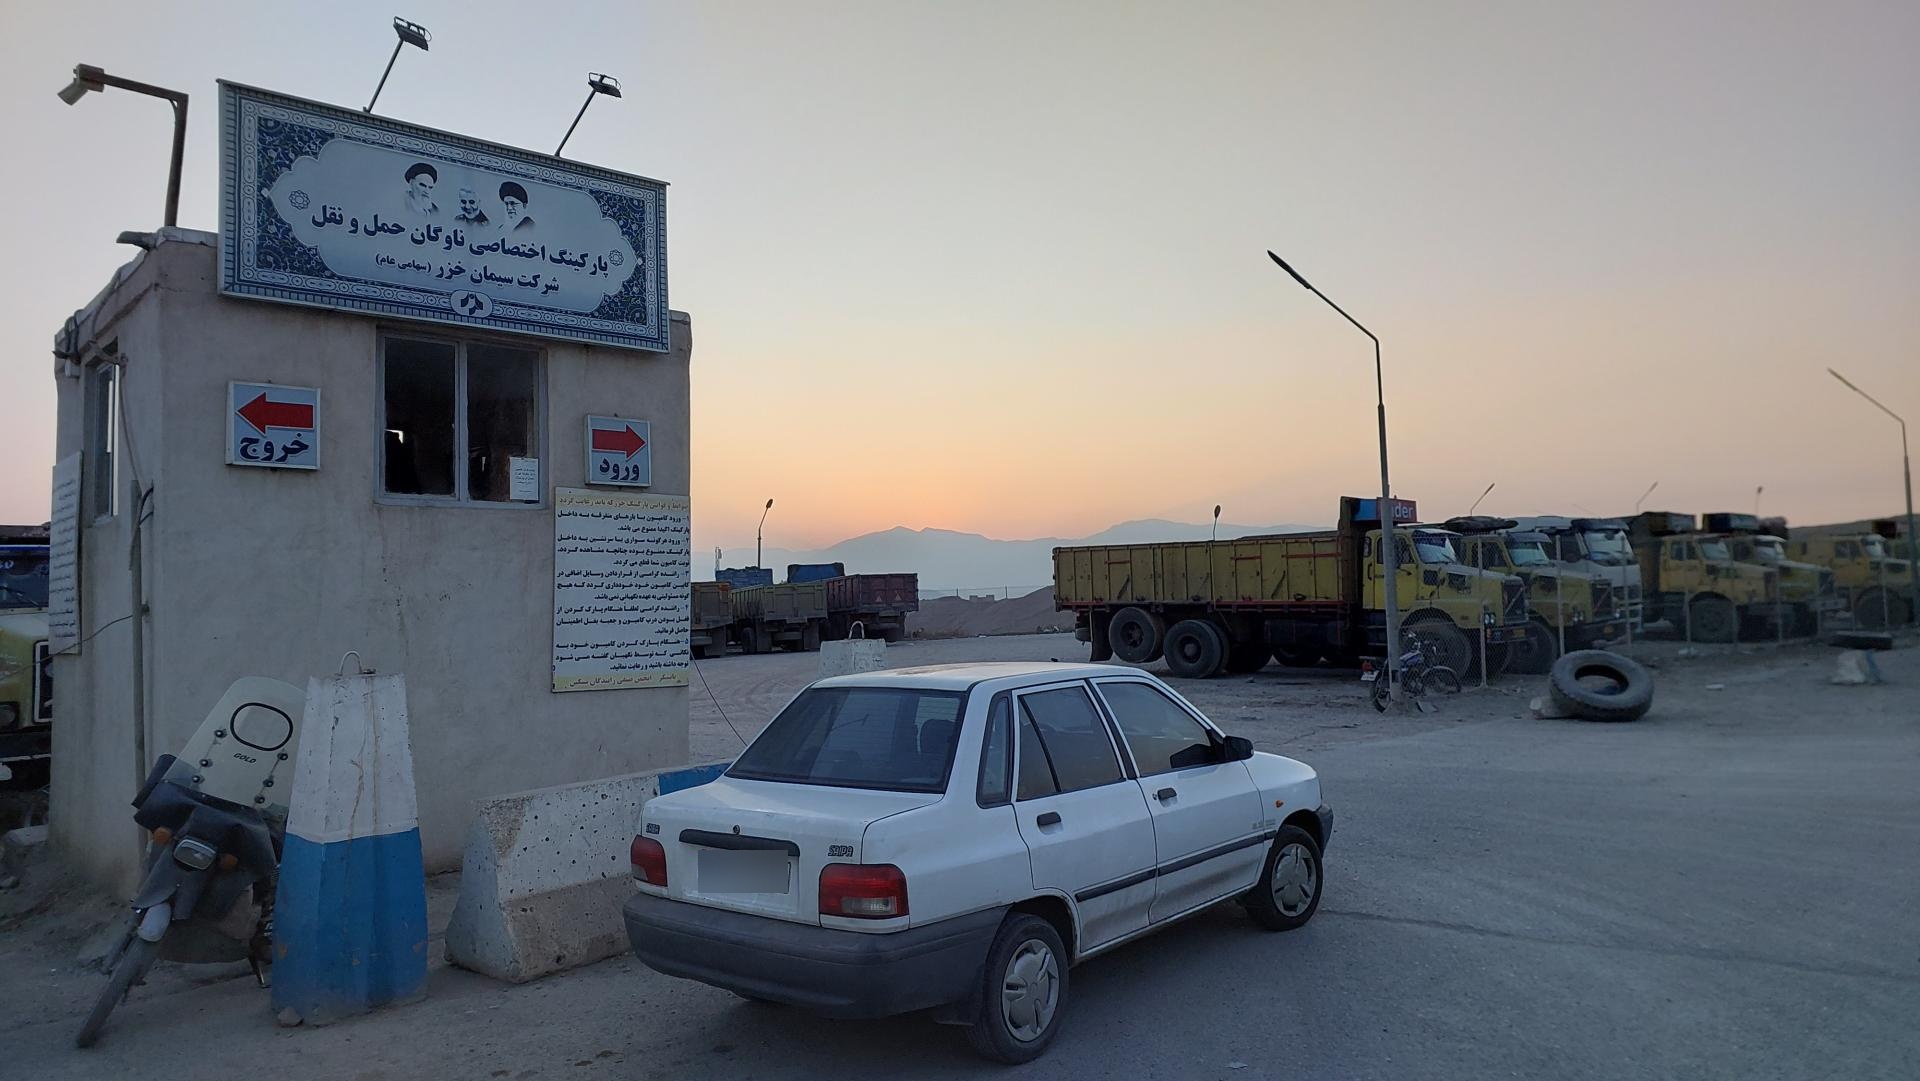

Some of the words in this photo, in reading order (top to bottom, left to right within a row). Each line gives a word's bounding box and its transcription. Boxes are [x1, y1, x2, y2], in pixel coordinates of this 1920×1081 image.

[311, 205, 344, 228] نقل
[348, 217, 359, 234] و
[363, 214, 406, 236] حمل
[410, 224, 465, 250] ناوگان
[469, 237, 546, 261] اختصاصی
[375, 253, 396, 266] عام)
[549, 249, 608, 278] پارکینگ
[435, 260, 466, 279] خزر
[470, 265, 513, 287] سیمان
[517, 273, 560, 294] شرکت
[240, 432, 309, 462] خروج
[600, 457, 640, 481] ورود
[558, 510, 578, 518] داخل
[1393, 503, 1415, 519] der
[614, 513, 634, 521] بارهای
[557, 534, 577, 542] داخل
[624, 536, 645, 544] سواری
[606, 547, 627, 556] چنانچه
[660, 559, 677, 567] کامیون
[557, 570, 564, 578] در
[583, 570, 603, 578] وسایل
[640, 570, 659, 578] گرامی
[620, 593, 638, 601] نگهبانی
[556, 606, 562, 614] از
[640, 605, 659, 613] گرامی
[623, 617, 645, 625] کامیون
[590, 641, 616, 649] کامیون
[617, 639, 638, 648] کردن
[640, 638, 659, 647] پارک
[556, 654, 573, 662] شود
[610, 652, 633, 660] نگهبان
[649, 660, 662, 668] باشید
[677, 660, 689, 668] توجه
[233, 753, 257, 763] GOLD
[828, 845, 854, 857] SAIPA
